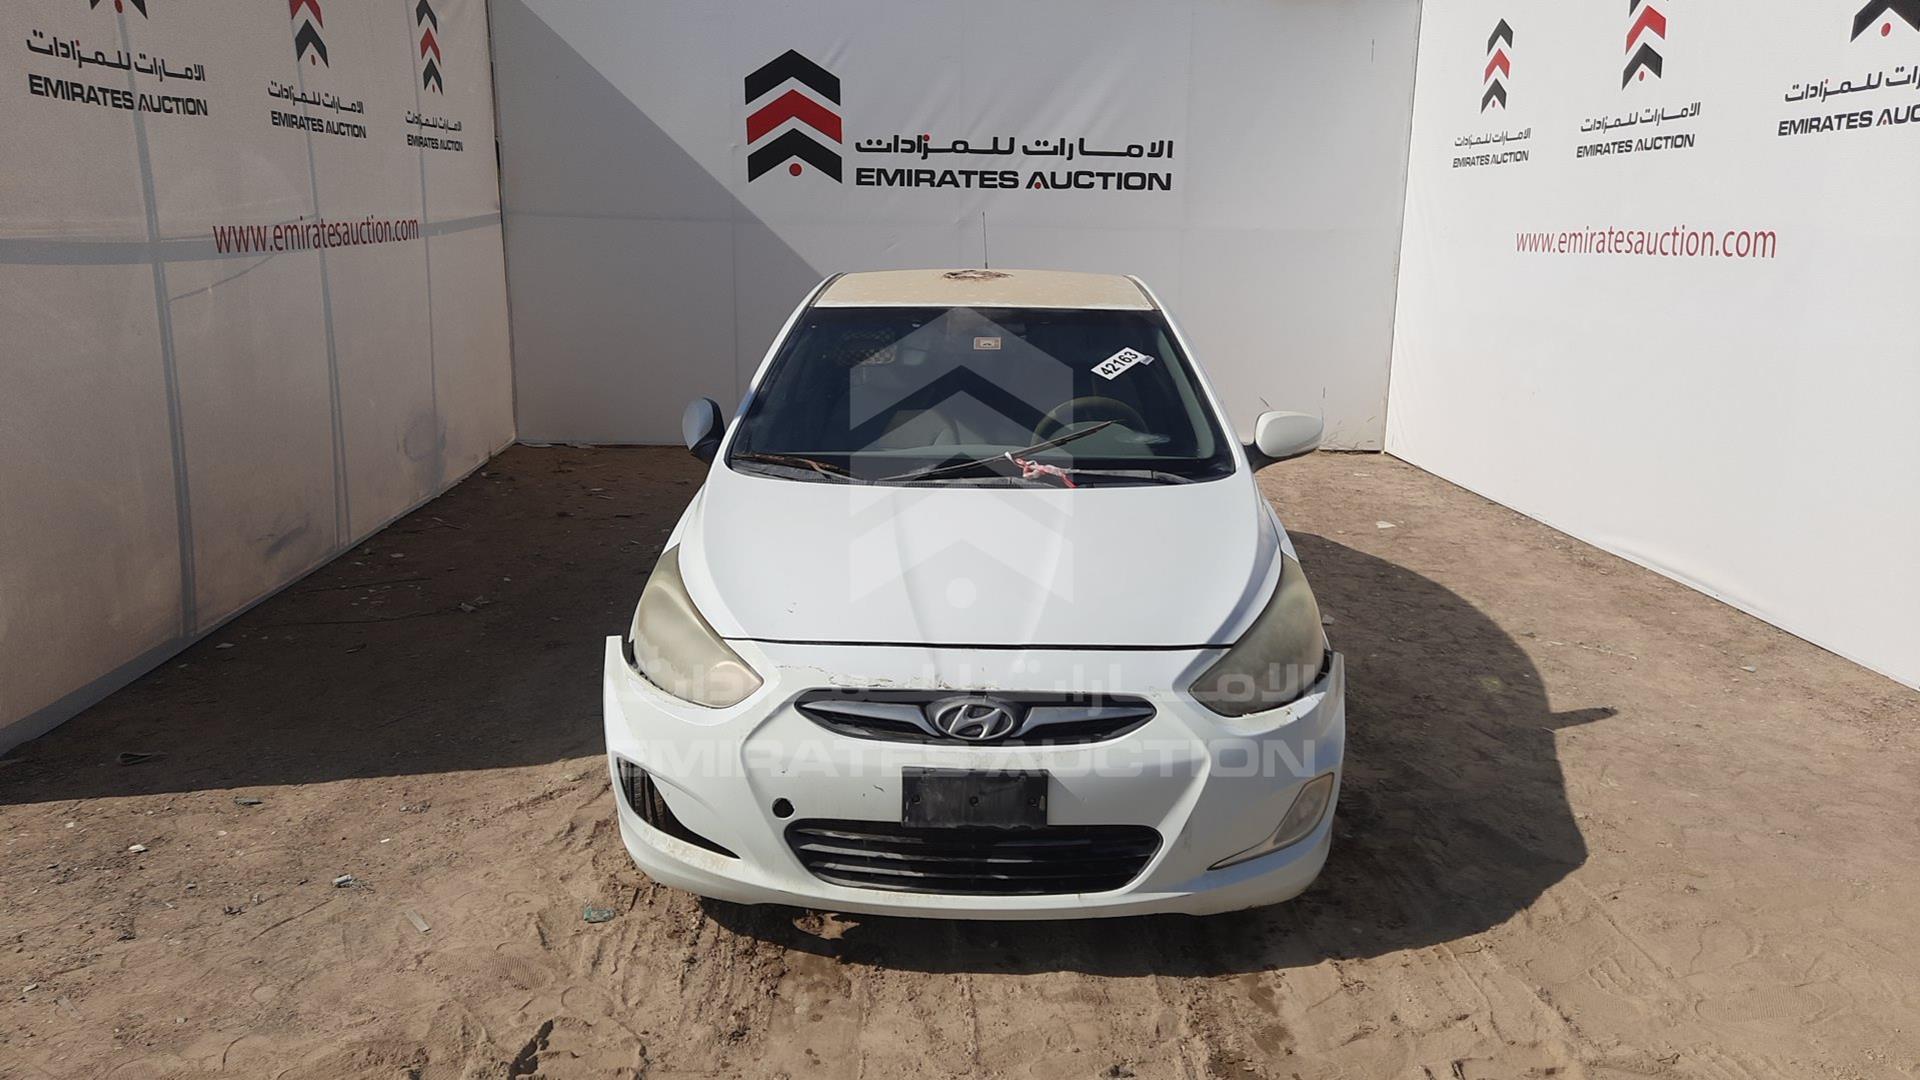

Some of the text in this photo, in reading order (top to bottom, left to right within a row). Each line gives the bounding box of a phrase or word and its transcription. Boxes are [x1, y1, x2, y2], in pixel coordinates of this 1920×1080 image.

[28, 73, 208, 116] EMIRATES AUCTION
[270, 110, 367, 139] EMIRATES AUCTION
[1777, 109, 1874, 136] EMIRATES
[406, 134, 464, 152] EMIRATES AUCTION
[855, 134, 1174, 160] الامارات للمزادات
[1575, 133, 1696, 159] EMIRATES AUCTION
[1452, 150, 1530, 169] EMIRATES AUCTION
[855, 167, 1172, 191] EMIRATES AUCTION
[212, 214, 420, 255] www.emiratesauction.com
[1515, 224, 1777, 259] www.emiratesauction.com
[1100, 350, 1139, 376] 42163
